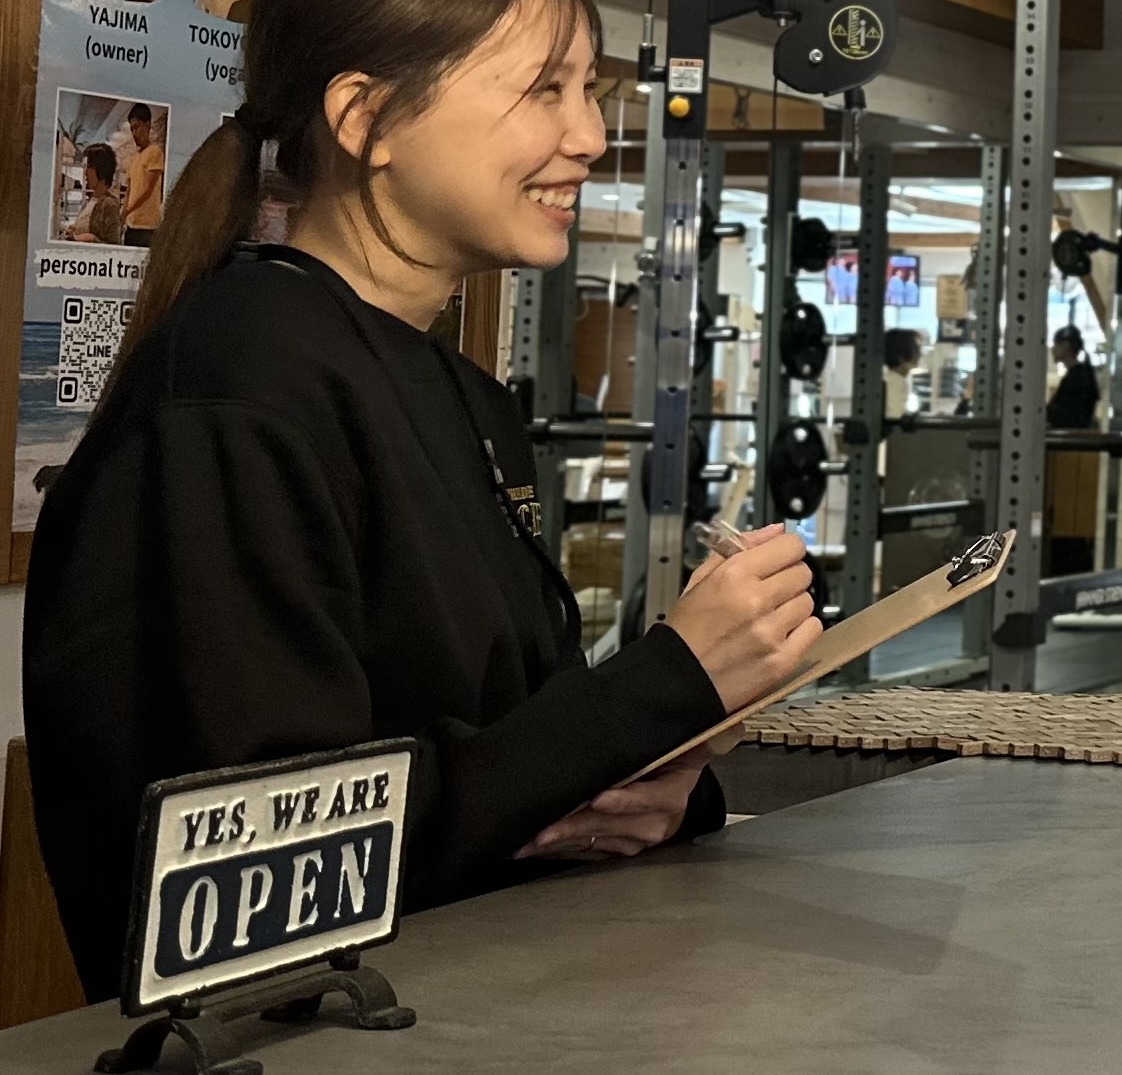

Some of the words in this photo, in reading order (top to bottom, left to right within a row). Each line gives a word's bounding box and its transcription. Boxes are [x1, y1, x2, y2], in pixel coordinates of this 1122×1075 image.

[90, 5, 149, 34] YAJIMA
[86, 35, 148, 68] (owner)
[189, 25, 244, 51] TOKOY
[40, 257, 113, 278] personal
[86, 344, 111, 357] LINE
[183, 797, 257, 852] YES,
[272, 786, 320, 832] WE
[325, 772, 389, 821] ARE
[178, 836, 373, 961] OPEN
